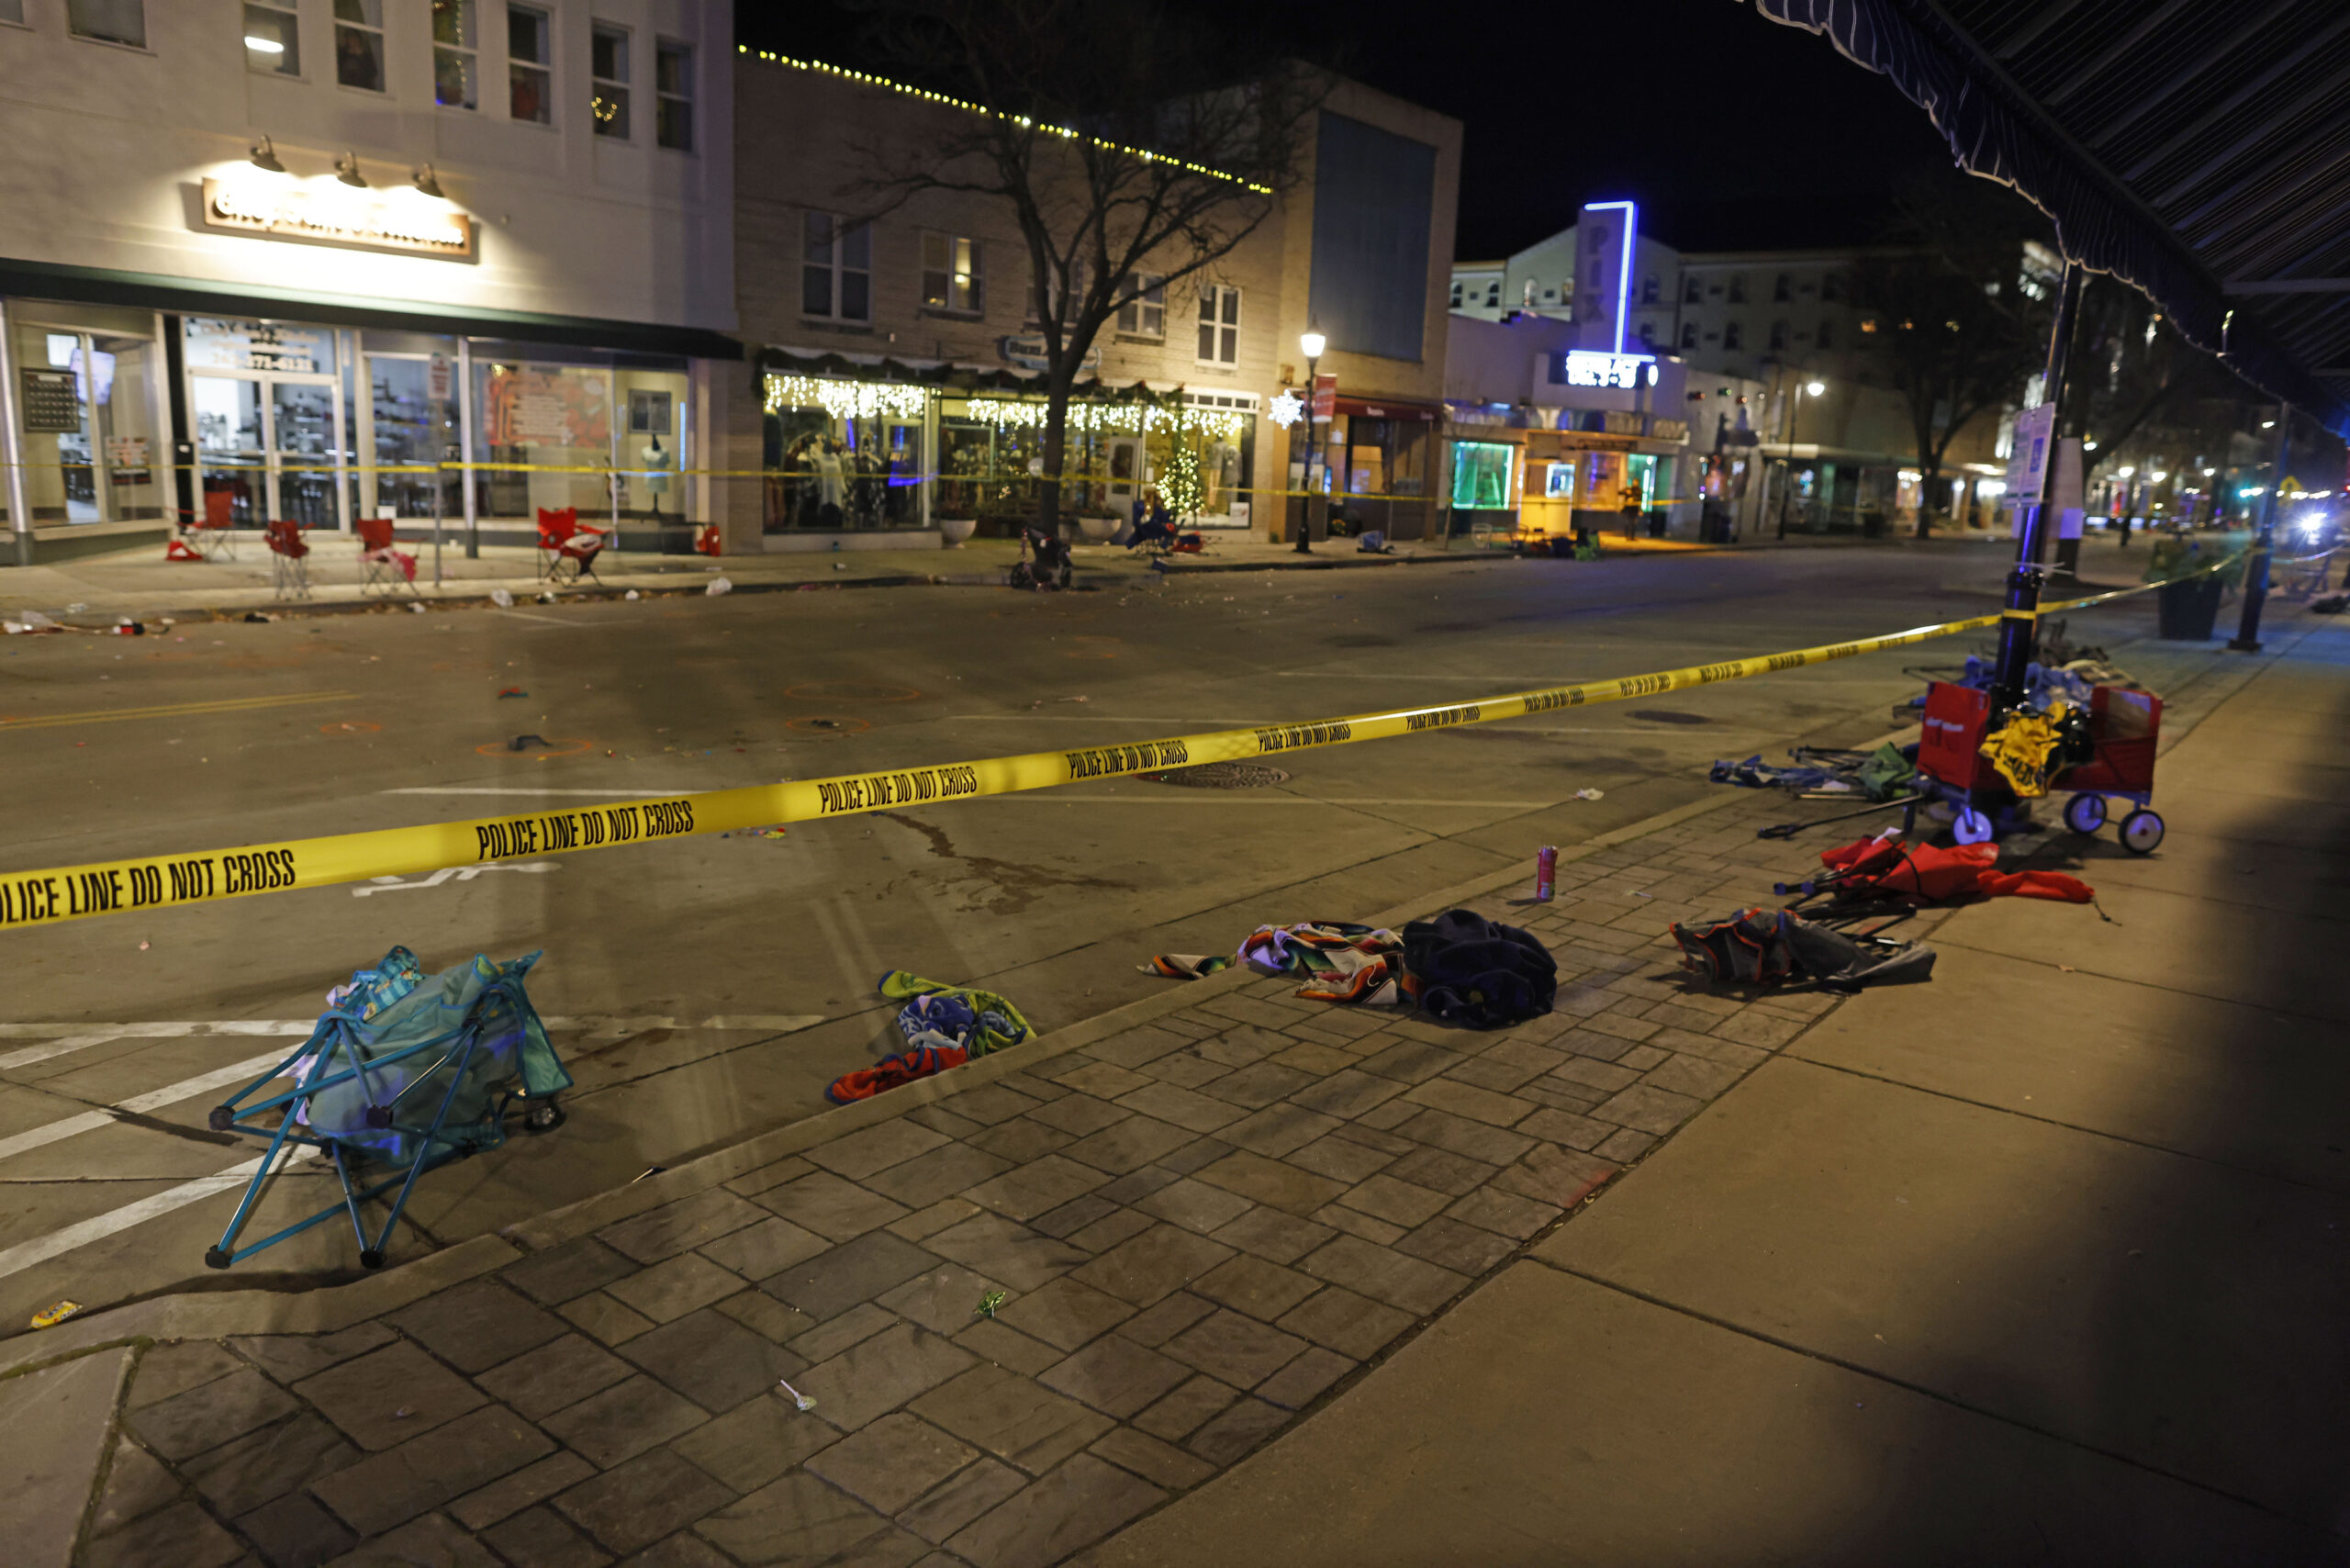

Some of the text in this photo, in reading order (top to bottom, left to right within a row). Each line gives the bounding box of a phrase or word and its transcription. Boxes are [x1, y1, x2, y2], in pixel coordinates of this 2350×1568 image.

[1065, 740, 1188, 778] POLICE LINE DO NOT CROSS
[1255, 720, 1351, 752] POLICE LINE DO NOT CROSS
[817, 766, 978, 814] POLICE LINE DO NOT CROSS
[476, 801, 695, 860] POLICE LINE DO NOT CROSS
[66, 870, 123, 915] LINE
[129, 865, 162, 906] DO
[168, 858, 216, 902] NOT
[223, 849, 297, 895] CROSS
